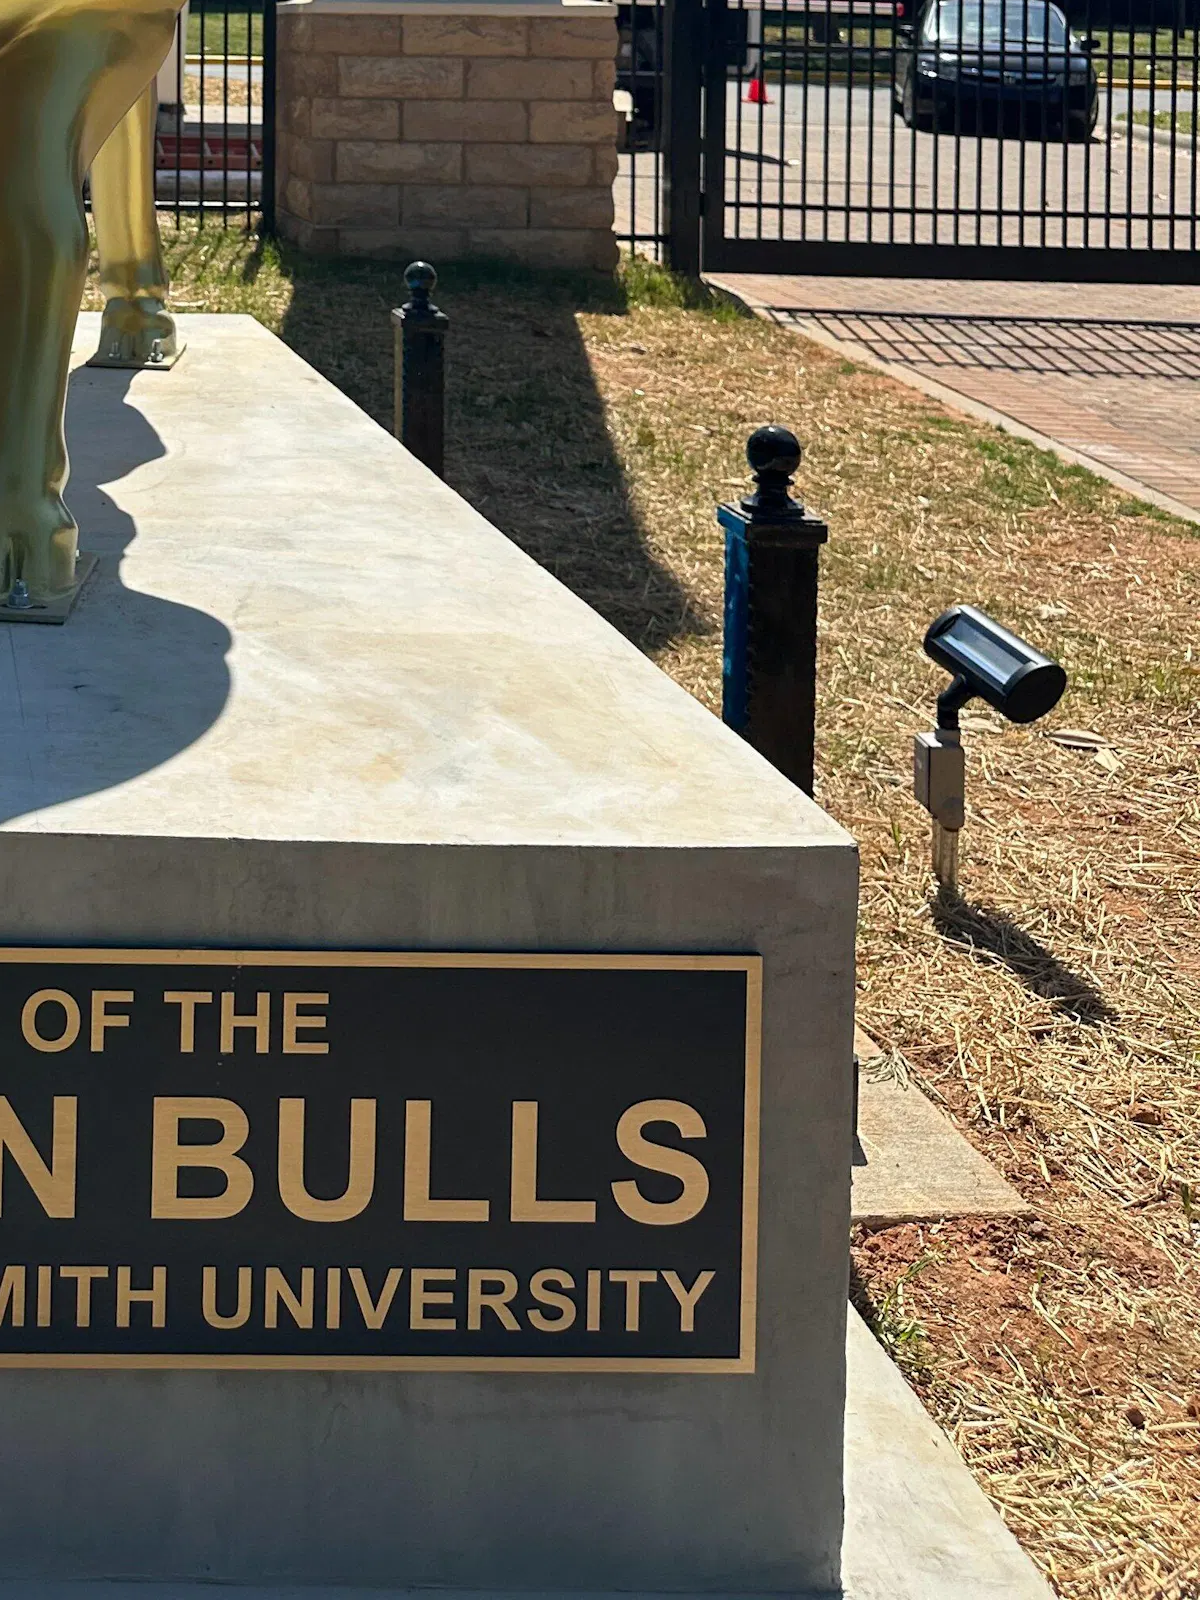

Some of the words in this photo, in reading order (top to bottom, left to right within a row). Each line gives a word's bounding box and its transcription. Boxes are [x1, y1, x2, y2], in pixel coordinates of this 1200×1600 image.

[20, 988, 135, 1053] OF
[163, 990, 330, 1056] THE
[150, 1095, 711, 1227] BULLS
[201, 1266, 714, 1333] UNIVERSITY
